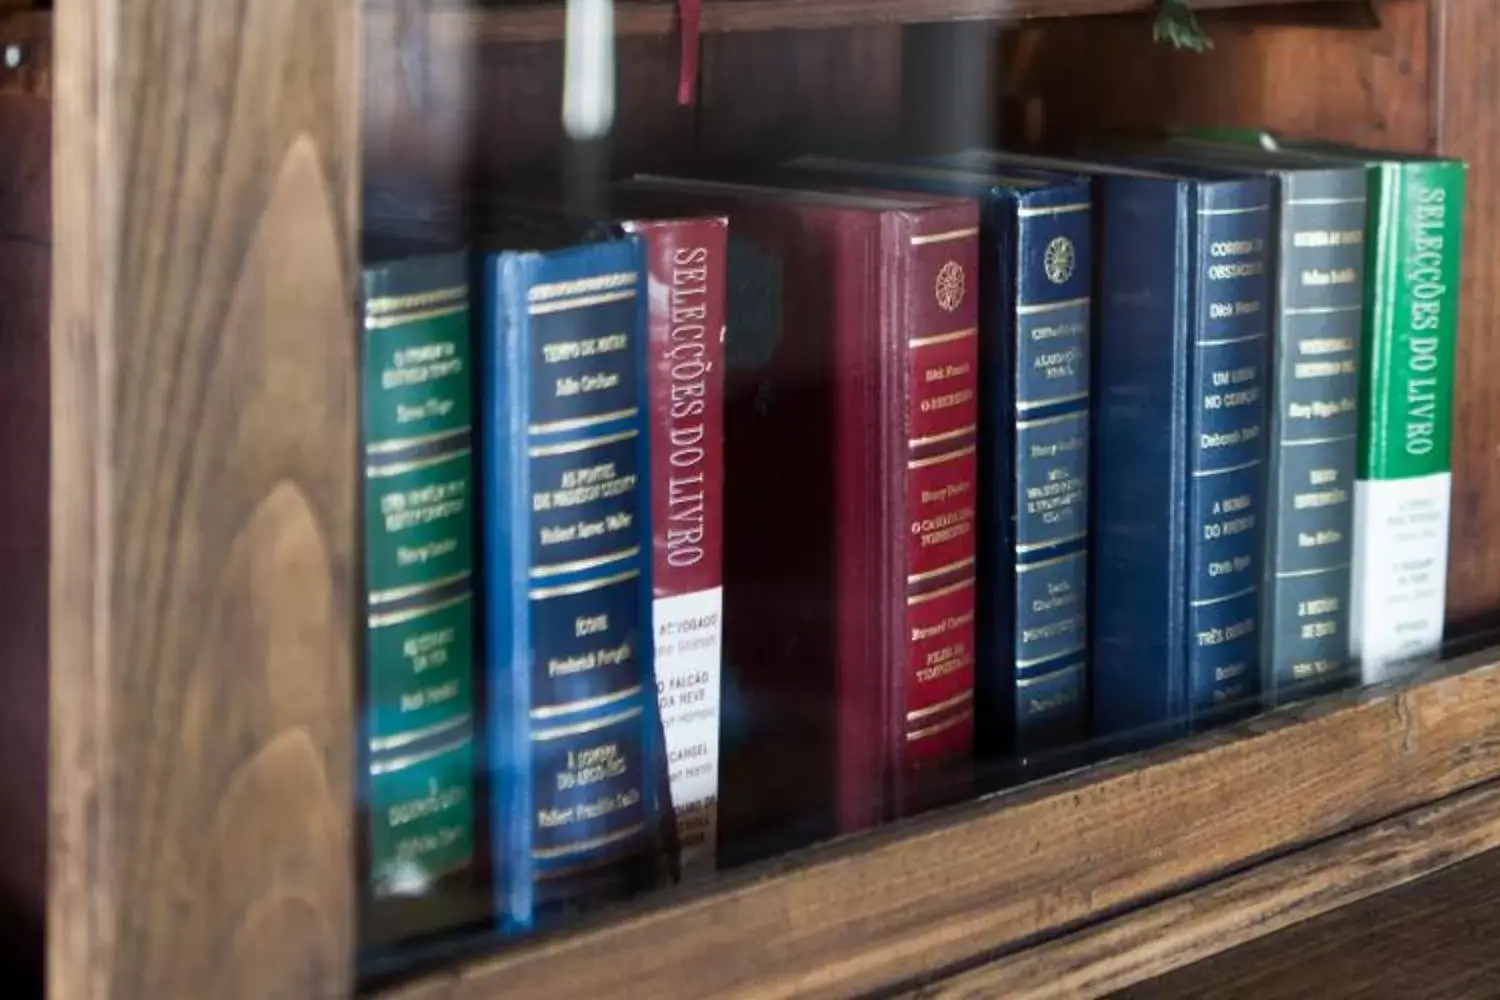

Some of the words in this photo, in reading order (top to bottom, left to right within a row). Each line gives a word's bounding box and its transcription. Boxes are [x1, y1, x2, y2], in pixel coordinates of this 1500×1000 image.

[1407, 187, 1447, 331] SELECÇÕES
[664, 247, 708, 417] SELECÇÕES
[1408, 336, 1440, 373] DO
[668, 423, 705, 467] DO
[1405, 376, 1437, 456] LIVRO
[666, 473, 705, 568] LIVRO
